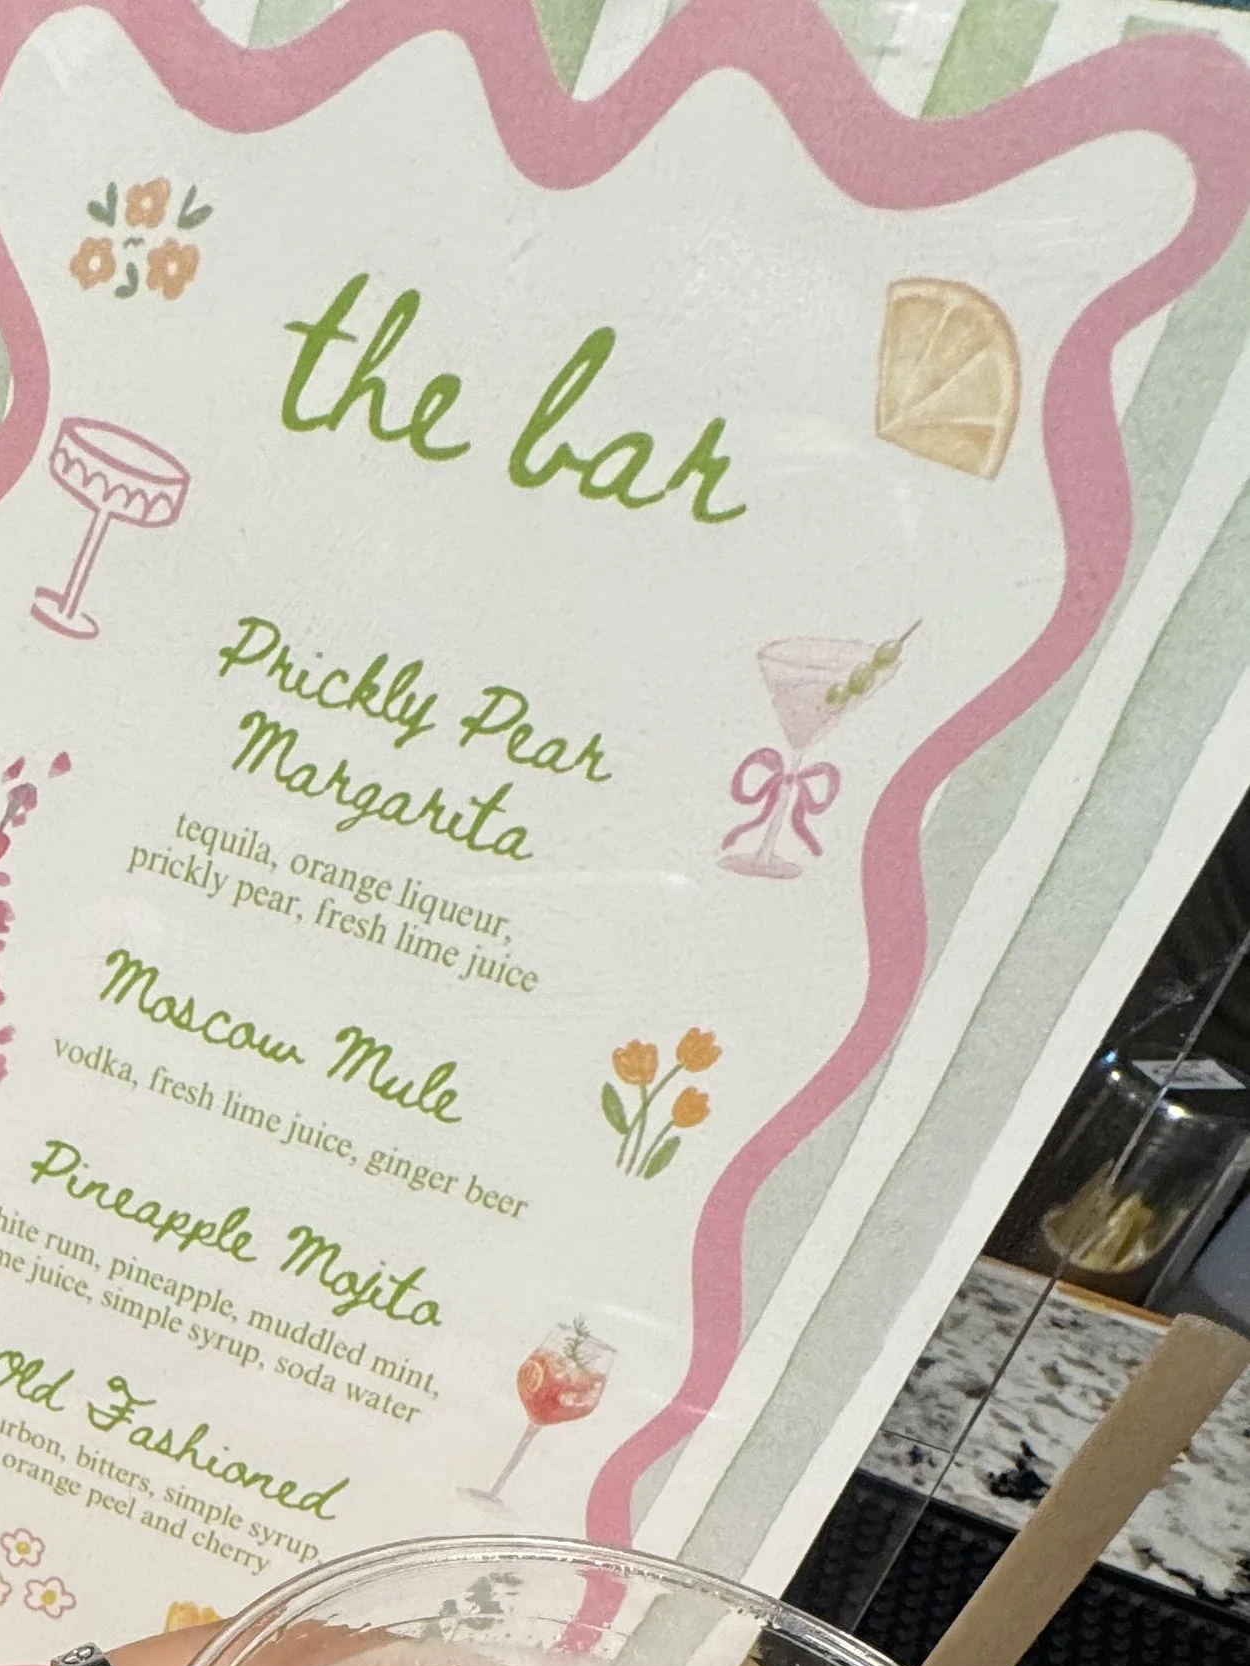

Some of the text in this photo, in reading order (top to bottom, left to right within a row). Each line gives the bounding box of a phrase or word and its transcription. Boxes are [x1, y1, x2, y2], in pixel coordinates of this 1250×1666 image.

[281, 272, 747, 524] the bar
[219, 616, 613, 781] Prickly Pear
[231, 711, 533, 860] Margarita
[126, 843, 540, 994] prickly pear, fresh lime juice
[175, 812, 513, 943] tequila, orange liqueur,
[98, 948, 463, 1125] Moscow Mule
[53, 1037, 530, 1221] vodka, fresh lime juice, ginger beer
[30, 1139, 443, 1327] Pineapple Mojito
[46, 1231, 102, 1272] rum,
[107, 1255, 239, 1323] pineapple,
[248, 1307, 368, 1367] muddled
[370, 1353, 440, 1399] mint,
[26, 1254, 94, 1303] juice,
[100, 1285, 183, 1338] simple
[187, 1319, 266, 1372] syrup,
[274, 1353, 337, 1394] soda
[346, 1379, 424, 1424] water
[1, 1452, 271, 1577] orange peel and cherry
[76, 1444, 155, 1498] bitters,
[163, 1484, 244, 1532] simple
[87, 1375, 351, 1521] Fashioned
